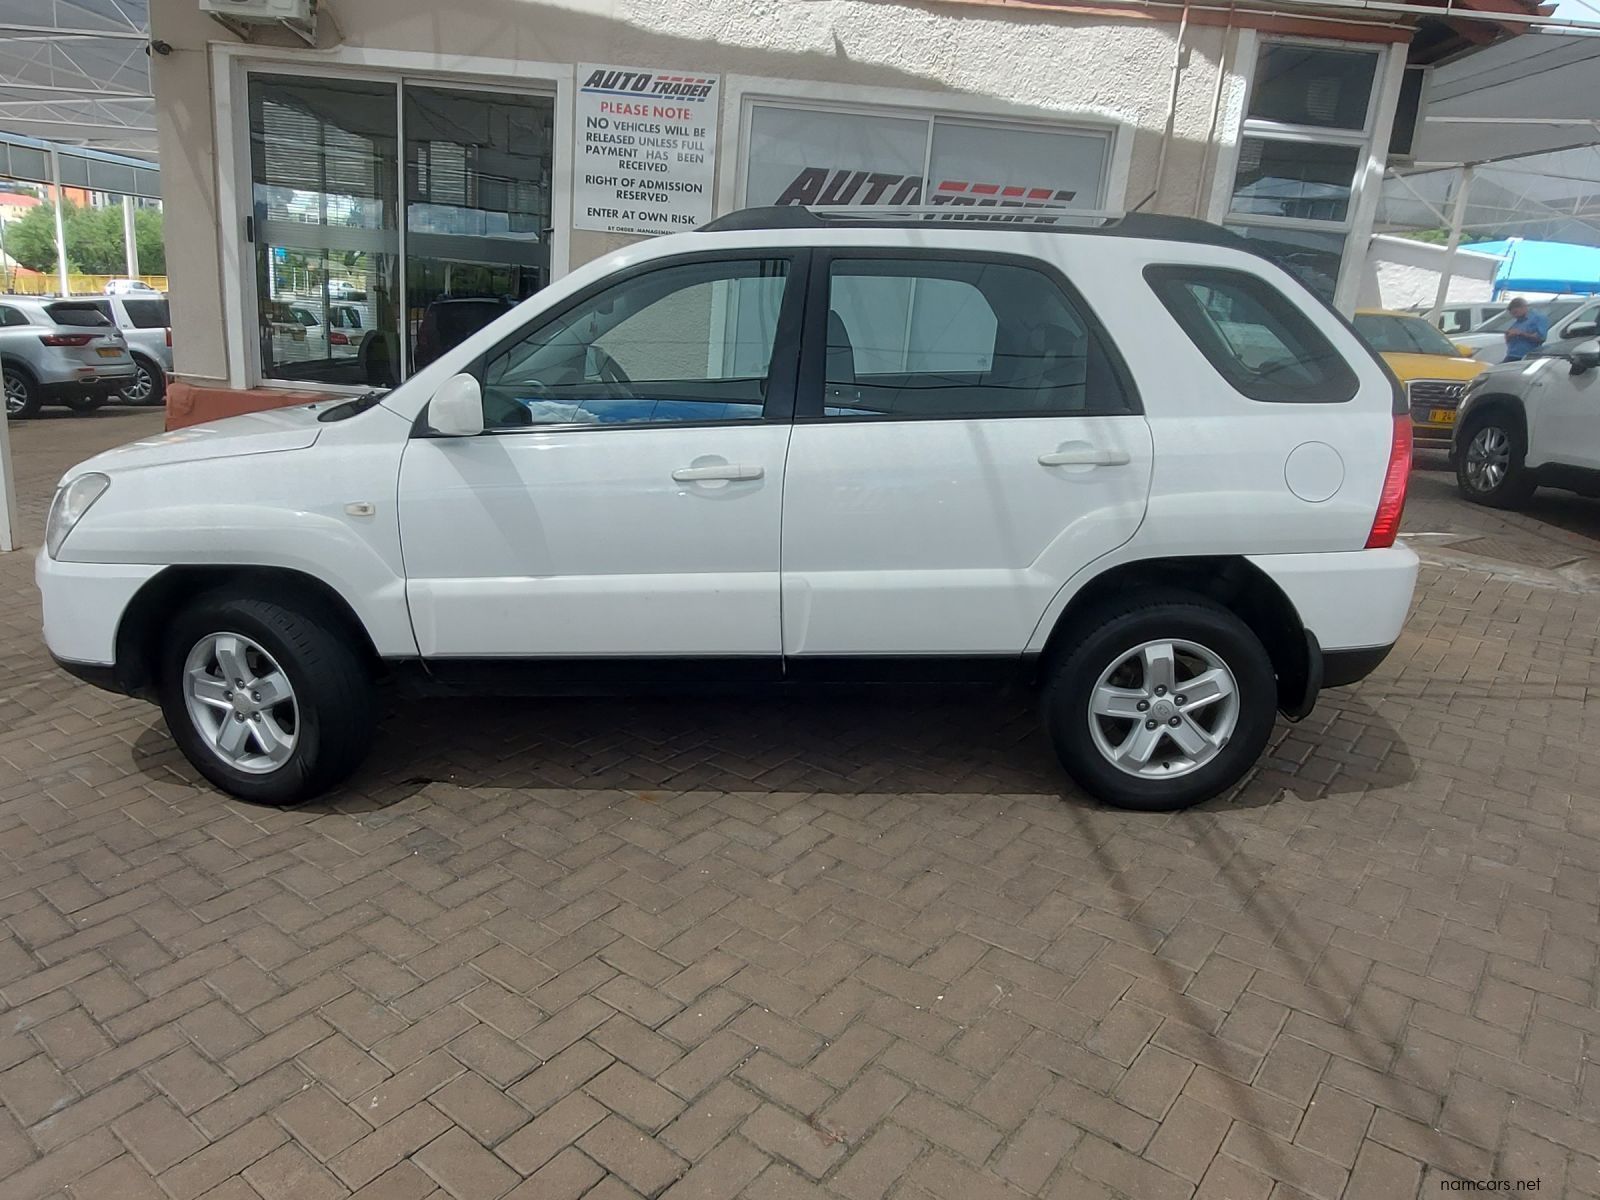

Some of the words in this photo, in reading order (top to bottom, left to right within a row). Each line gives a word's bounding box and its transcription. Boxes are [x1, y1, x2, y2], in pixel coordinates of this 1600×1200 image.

[584, 70, 652, 91] AUTO
[651, 82, 712, 97] TRADER
[600, 102, 649, 116] PLEASE
[587, 117, 609, 129] NO
[613, 121, 660, 133] VEHICLES
[665, 125, 689, 136] WILL
[694, 128, 706, 137] BE
[586, 132, 635, 145] RELEASED
[639, 137, 678, 149] UNLESS
[682, 141, 704, 150] FULL
[585, 146, 638, 158] PAYMENT
[646, 151, 669, 160] HAS
[677, 154, 704, 163] BEEN
[585, 175, 618, 186] RIGHT
[621, 178, 636, 187] OF
[639, 180, 703, 193] ADMISSION
[774, 166, 930, 206] AUTO
[587, 208, 618, 218] ENTER
[622, 211, 635, 219] AT
[638, 212, 668, 222] OWN
